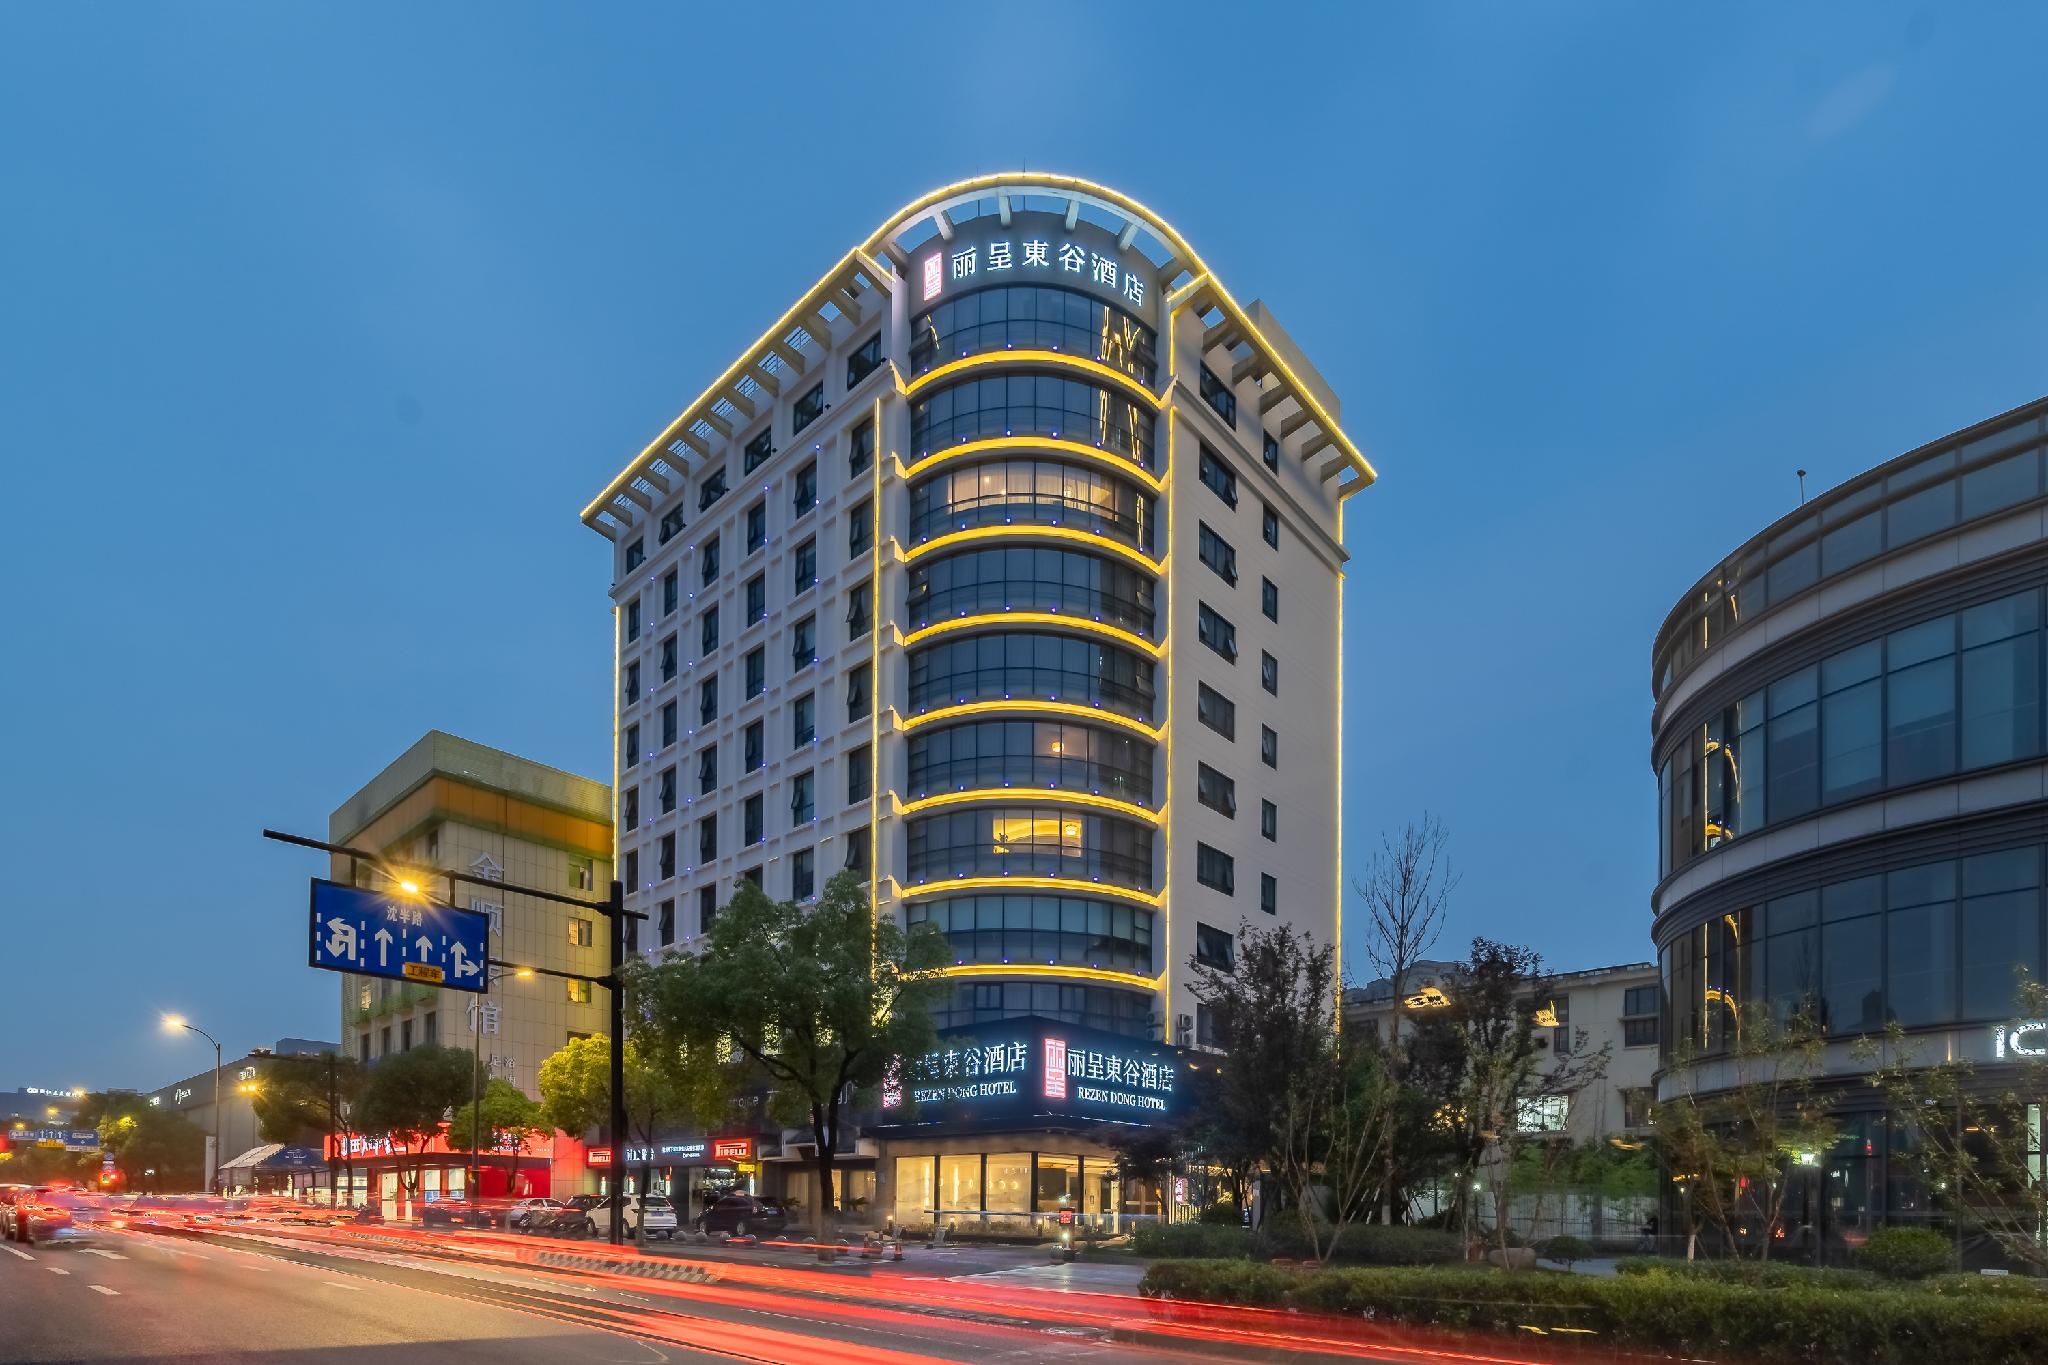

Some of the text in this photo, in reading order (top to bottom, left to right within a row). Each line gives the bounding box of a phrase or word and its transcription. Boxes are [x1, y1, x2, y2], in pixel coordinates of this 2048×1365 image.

[951, 239, 1144, 306] 丽呈東谷酒店
[386, 905, 423, 927] 沈半路
[407, 963, 441, 981] 工程车
[1067, 1048, 1175, 1092] 丽呈東谷酒店
[979, 1080, 1017, 1097] HOTEL
[1077, 1086, 1166, 1111] REZEN DONG HOTEL
[715, 1142, 748, 1157] PIRELLI
